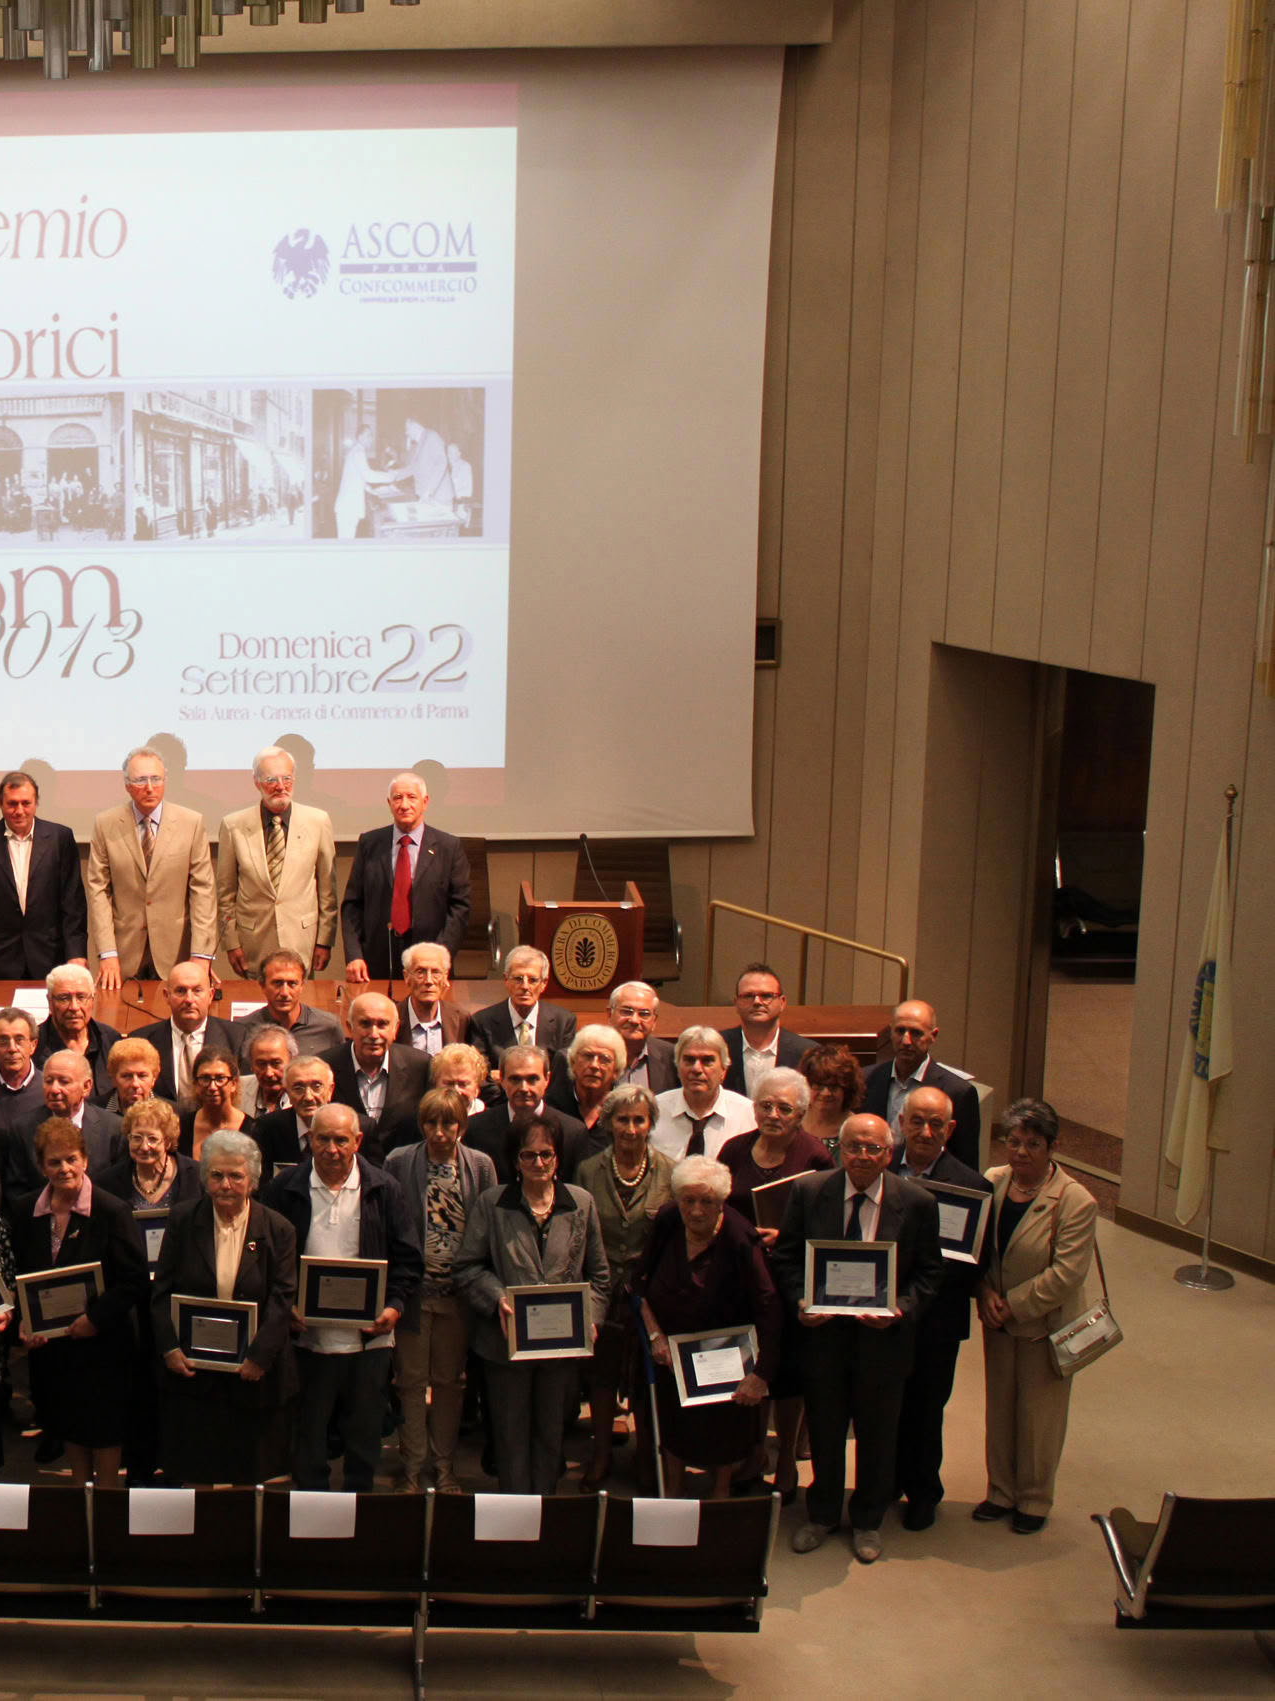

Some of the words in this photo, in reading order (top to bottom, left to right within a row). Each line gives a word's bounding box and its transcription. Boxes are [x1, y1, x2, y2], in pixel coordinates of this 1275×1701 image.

[340, 221, 478, 259] ASCOM
[372, 264, 446, 273] PARMA
[219, 631, 372, 660] Domenica
[180, 663, 371, 696] Settembre
[372, 624, 473, 693] 22
[179, 704, 206, 721] Sala
[211, 705, 250, 720] Aurea
[315, 704, 328, 720] di
[330, 703, 408, 720] Commercio
[410, 703, 423, 719] di
[426, 703, 469, 719] Parma
[565, 976, 604, 988] PARMA
